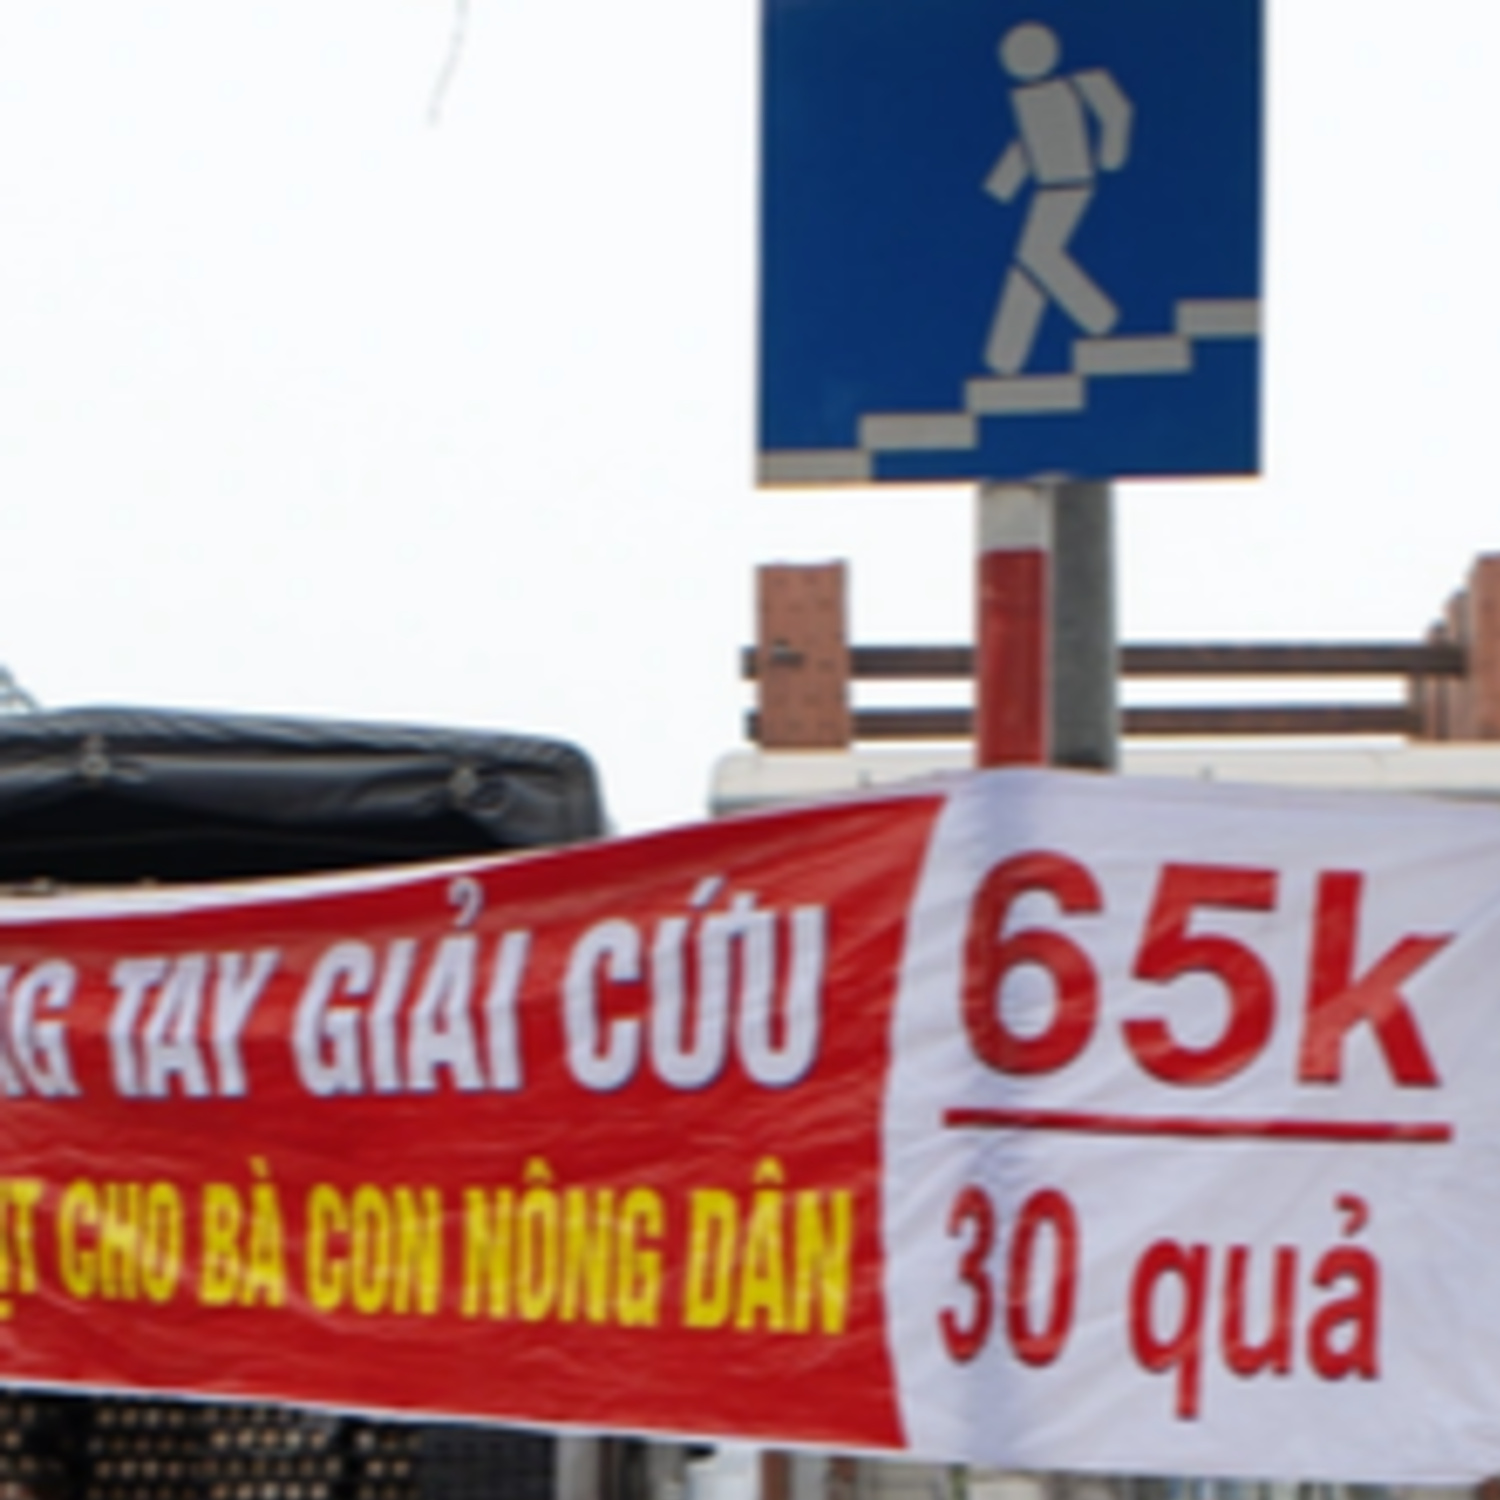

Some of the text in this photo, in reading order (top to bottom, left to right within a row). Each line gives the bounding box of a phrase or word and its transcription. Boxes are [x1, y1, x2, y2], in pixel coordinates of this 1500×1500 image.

[107, 948, 282, 1099] TAY
[291, 876, 532, 1098] GIẢI
[561, 874, 826, 1092] CỨU
[959, 850, 1456, 1087] 65k
[57, 1179, 184, 1305] CHO
[198, 1156, 290, 1308] BÀ
[304, 1183, 444, 1316] CON
[460, 1157, 665, 1328] NÔNG
[682, 1156, 854, 1336] DÂN
[937, 1185, 1382, 1420] 30 quả
